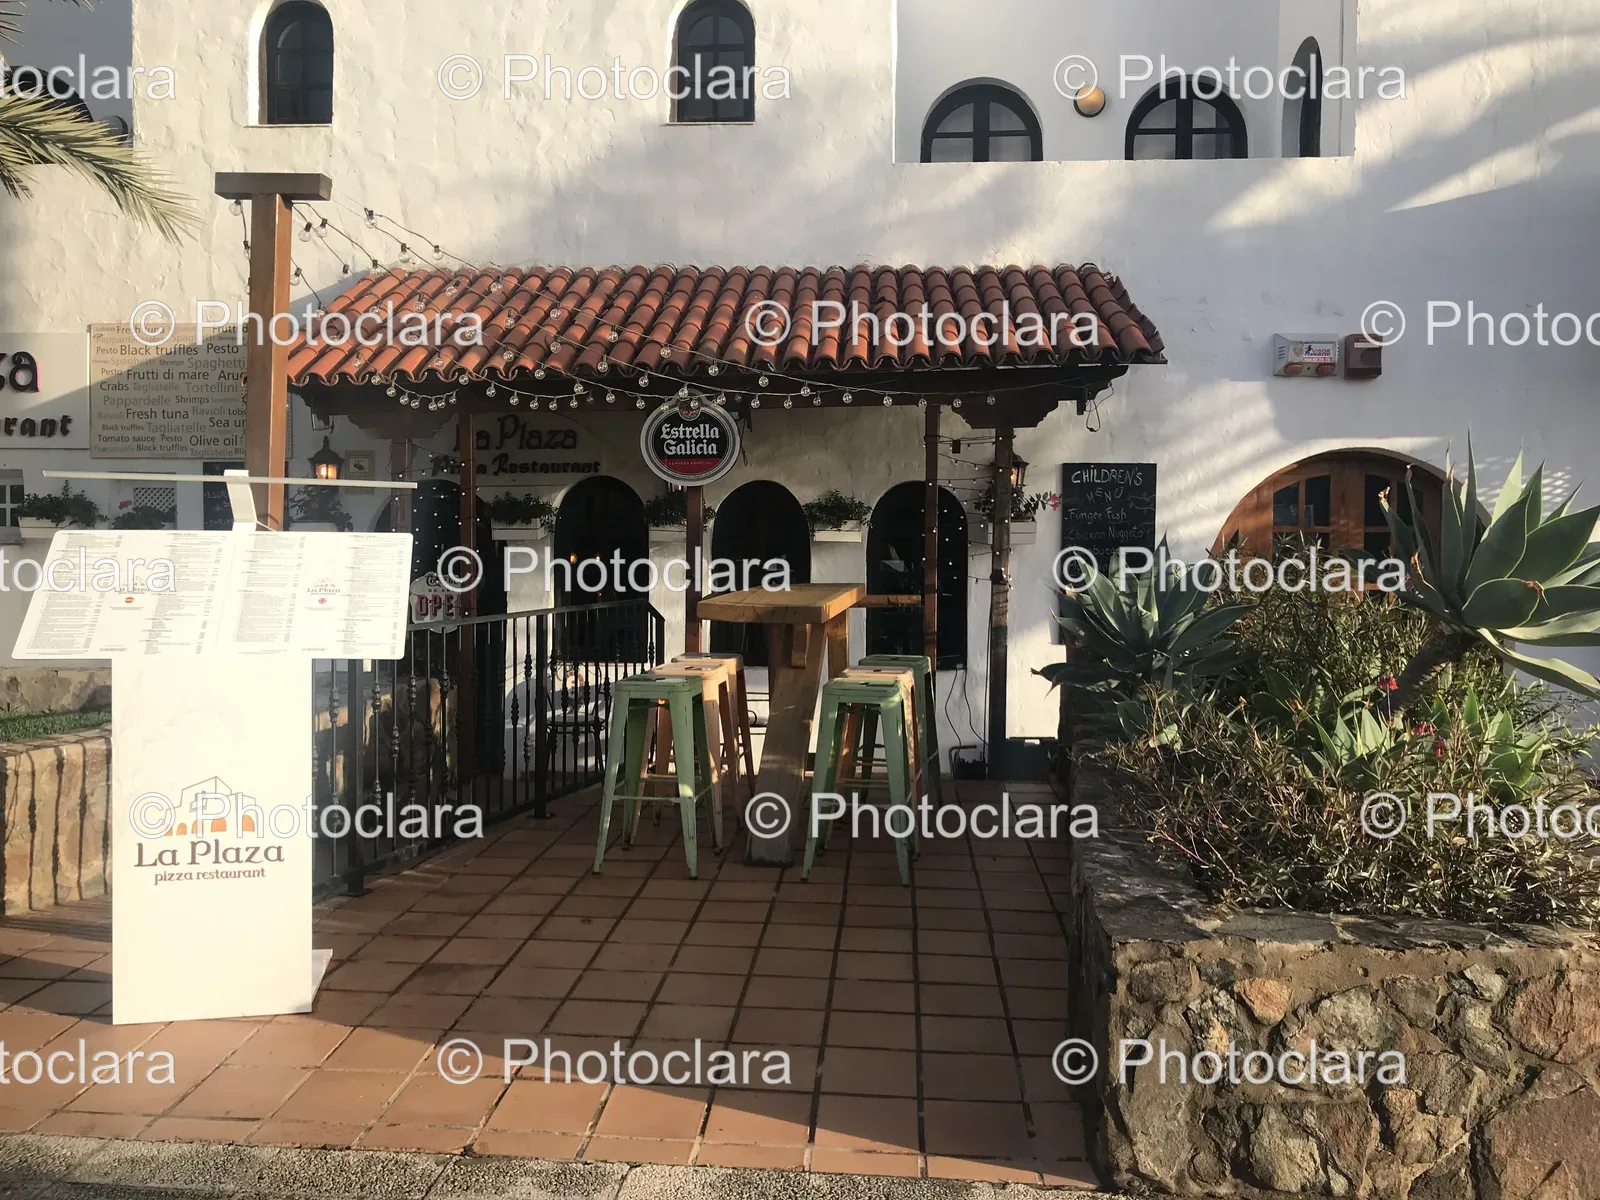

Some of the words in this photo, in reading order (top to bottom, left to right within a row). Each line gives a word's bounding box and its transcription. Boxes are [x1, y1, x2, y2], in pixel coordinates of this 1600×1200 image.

[96, 346, 118, 355] Pesto
[120, 344, 151, 355] Black
[155, 343, 199, 356] truffles
[206, 342, 239, 354] Pesto
[187, 357, 247, 371] Spaghetti
[101, 367, 123, 376] Pesto
[126, 368, 159, 380] Frutti
[163, 368, 174, 380] di
[179, 371, 209, 380] mare
[100, 381, 130, 391] Crabs
[185, 381, 238, 393] Tortellini
[103, 394, 171, 409] Pappardelle
[175, 394, 209, 405] Shrimps
[126, 407, 157, 419] Fresh
[161, 408, 189, 420] tuna
[192, 406, 225, 416] Ravioli
[145, 421, 206, 435] Tagliatelle
[209, 416, 229, 428] Sea
[97, 434, 130, 443] Tomato
[132, 434, 156, 443] sauce
[161, 433, 183, 442] Pesto
[495, 413, 577, 450] Plaza
[660, 423, 720, 440] Estrella
[136, 443, 157, 452] Black
[160, 443, 188, 452] truffles
[189, 434, 220, 447] Olive
[223, 434, 238, 447] oil
[663, 439, 718, 456] Galicia
[491, 452, 601, 476] Restaurant
[1104, 507, 1127, 520] Fish
[134, 842, 180, 867] La
[187, 838, 285, 866] Plaza
[154, 870, 194, 886] pizza
[195, 866, 267, 880] restaurant
